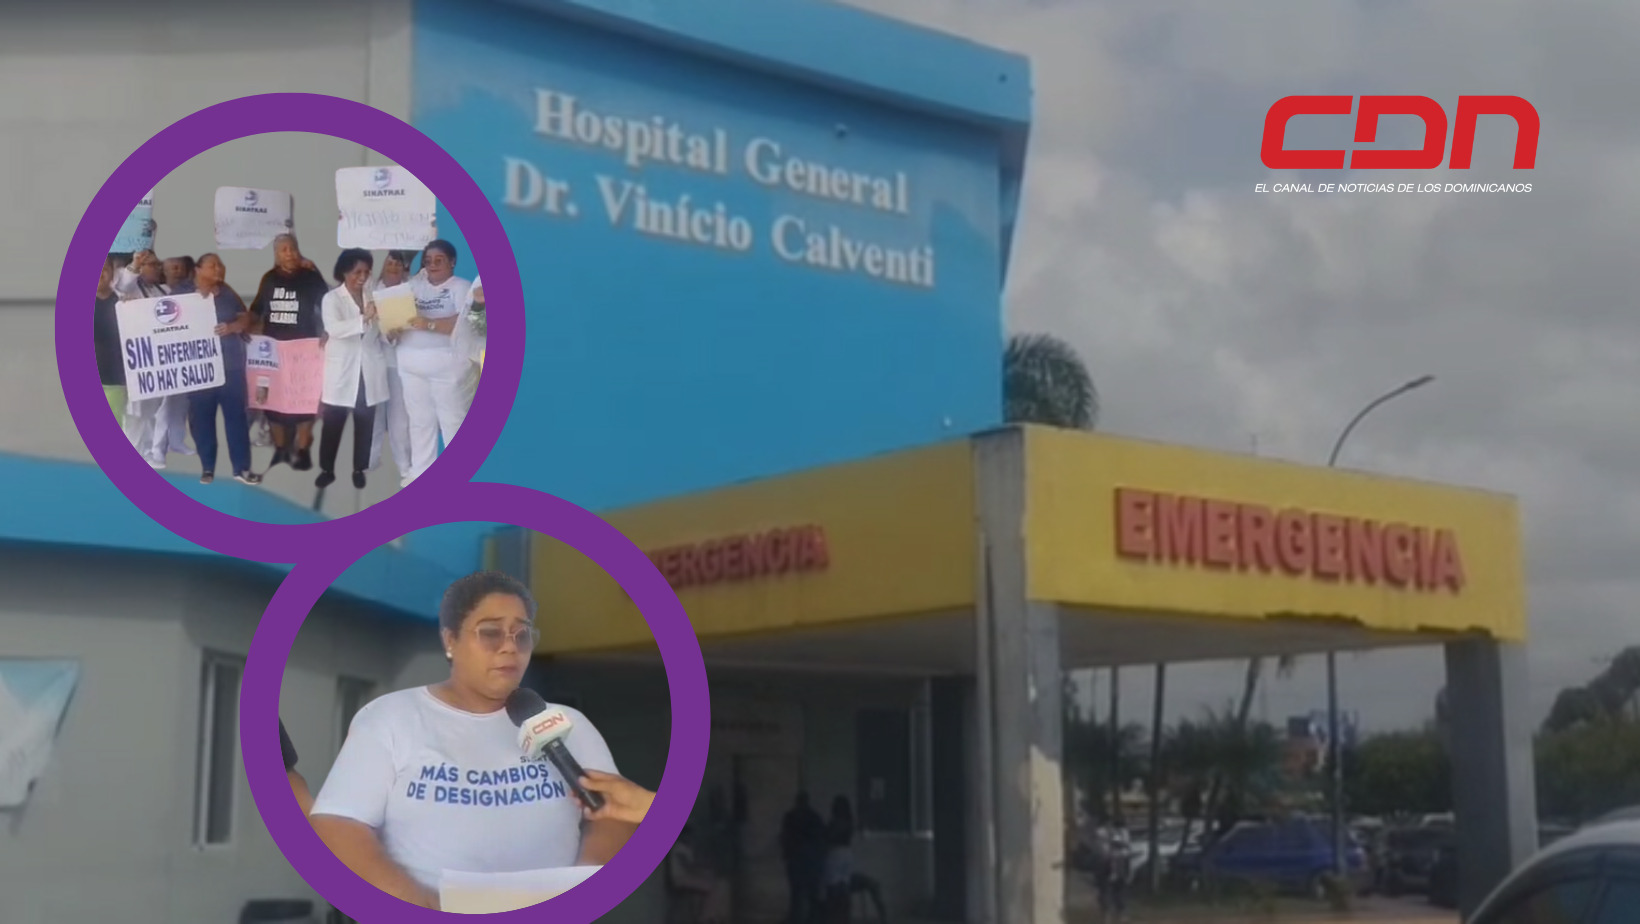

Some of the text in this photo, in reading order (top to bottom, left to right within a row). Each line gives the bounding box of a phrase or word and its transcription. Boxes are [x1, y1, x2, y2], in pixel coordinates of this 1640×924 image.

[533, 88, 909, 214] Hospital General
[502, 157, 935, 287] Dr. Vinício Calventi
[273, 287, 285, 299] NO
[125, 335, 218, 370] SIN ENFERMERIA
[137, 365, 215, 395] NO HAY SALUD
[1114, 486, 1464, 593] EMERGENCIA
[420, 762, 549, 786] MÁS CAMBIOS
[407, 778, 566, 807] DE DESIGNACIÓN
